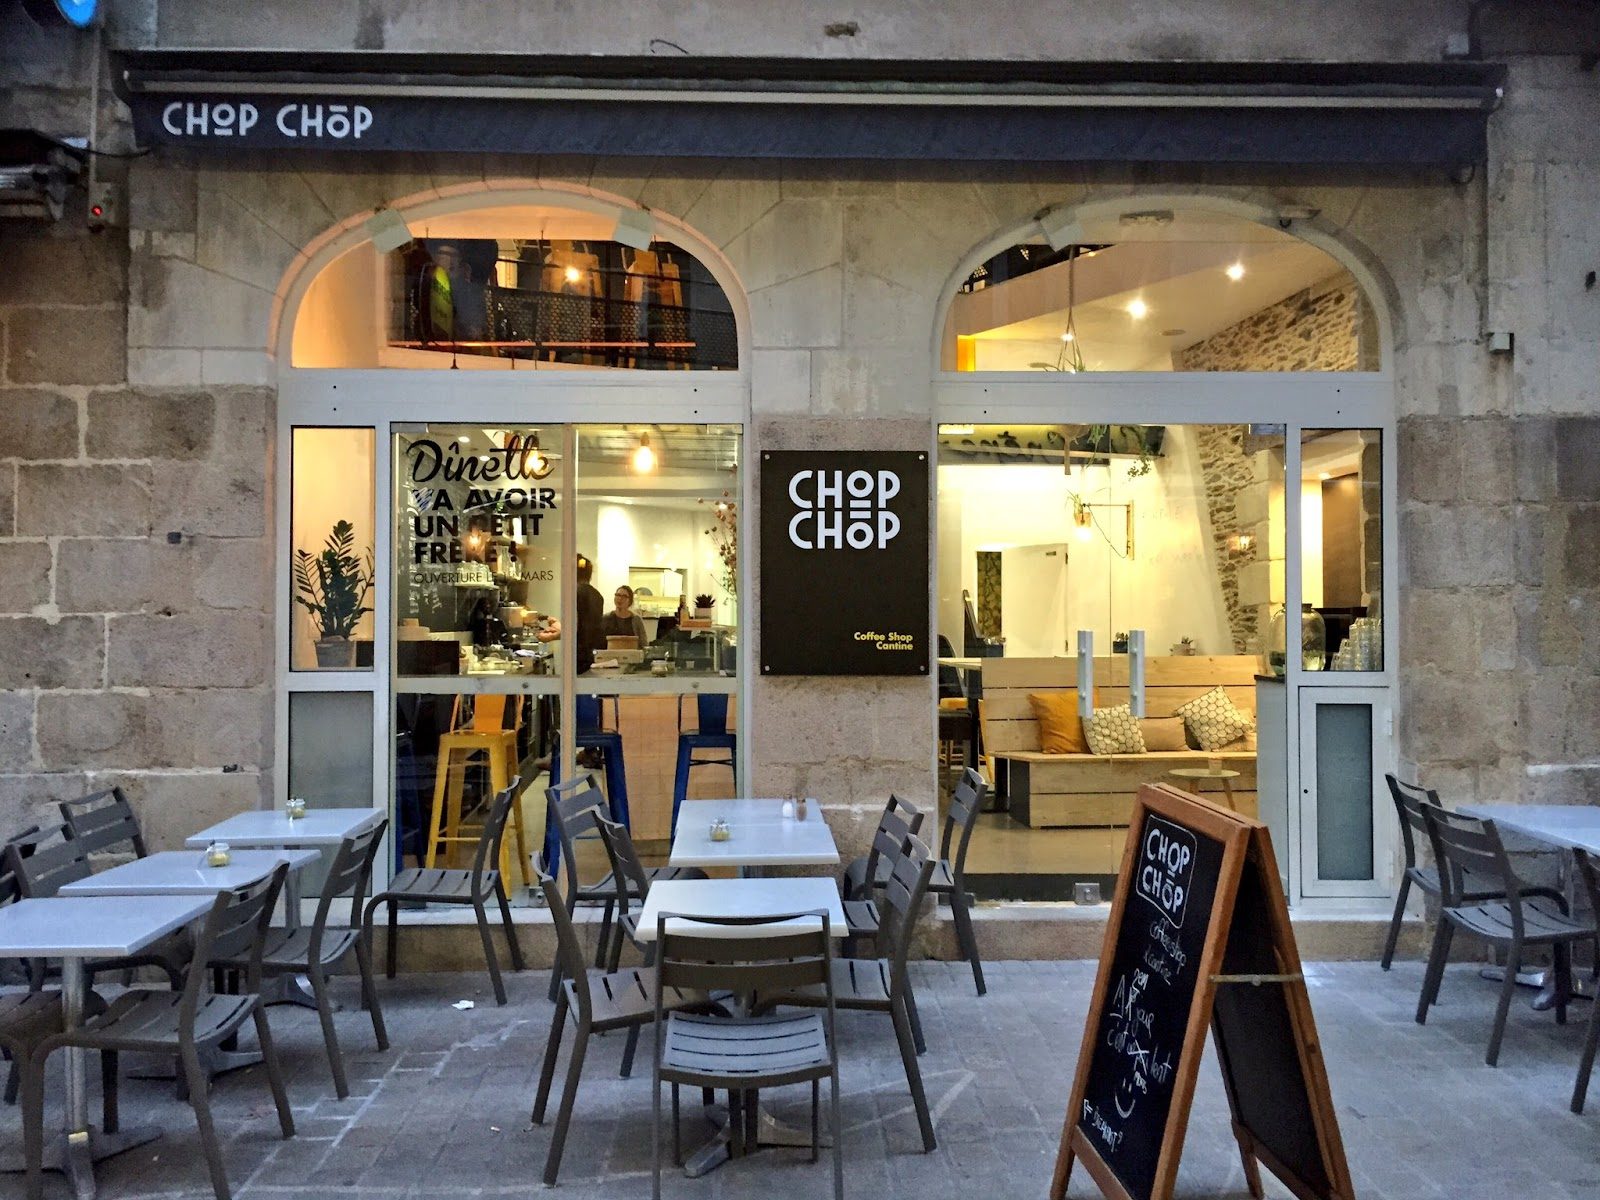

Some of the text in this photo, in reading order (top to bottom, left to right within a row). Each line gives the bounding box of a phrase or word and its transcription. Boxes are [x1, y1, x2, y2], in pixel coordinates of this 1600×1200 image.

[162, 102, 259, 136] CHOP
[464, 487, 557, 511] AVOIR
[788, 470, 901, 509] CHOP
[414, 515, 459, 538] UN
[413, 572, 483, 584] OUVERTURE
[520, 570, 554, 581] MARS
[854, 632, 913, 643] Coffee Shop
[876, 641, 914, 650] Cantine
[1146, 828, 1190, 877] CHOP
